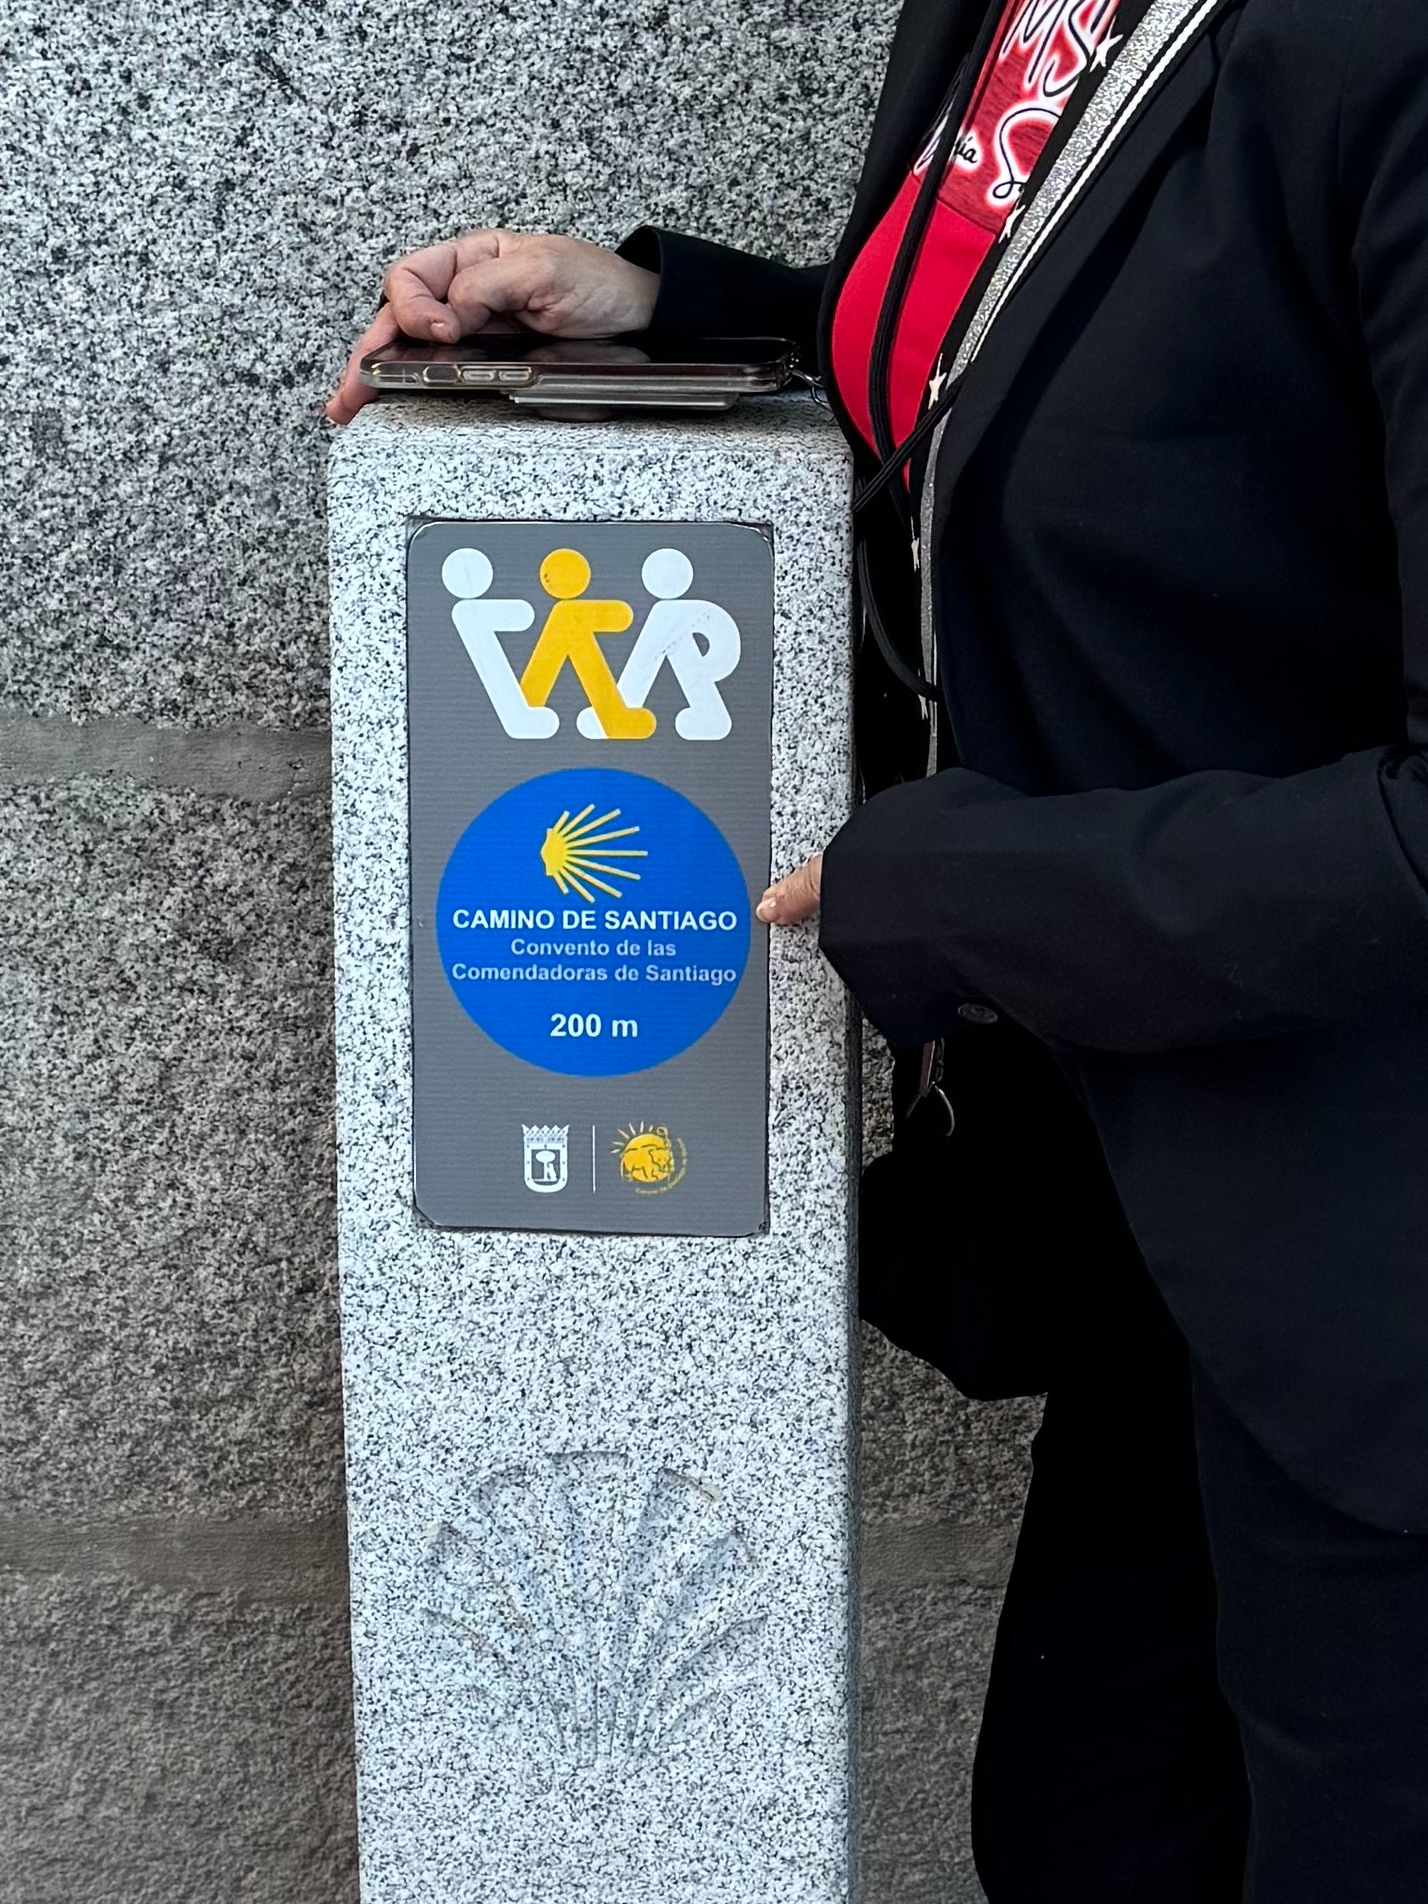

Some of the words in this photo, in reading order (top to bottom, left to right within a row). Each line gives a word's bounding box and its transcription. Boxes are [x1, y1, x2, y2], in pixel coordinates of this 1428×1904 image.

[452, 909, 555, 929] CAMINO
[562, 910, 597, 930] DE
[604, 910, 738, 931] SANTIAGO
[511, 938, 610, 957] Convento
[616, 939, 641, 957] de
[647, 939, 677, 957] las
[452, 962, 608, 981] Comendadoras
[614, 964, 640, 981] de
[645, 964, 737, 986] Santiago
[550, 1013, 602, 1038] 200
[611, 1018, 639, 1038] m
